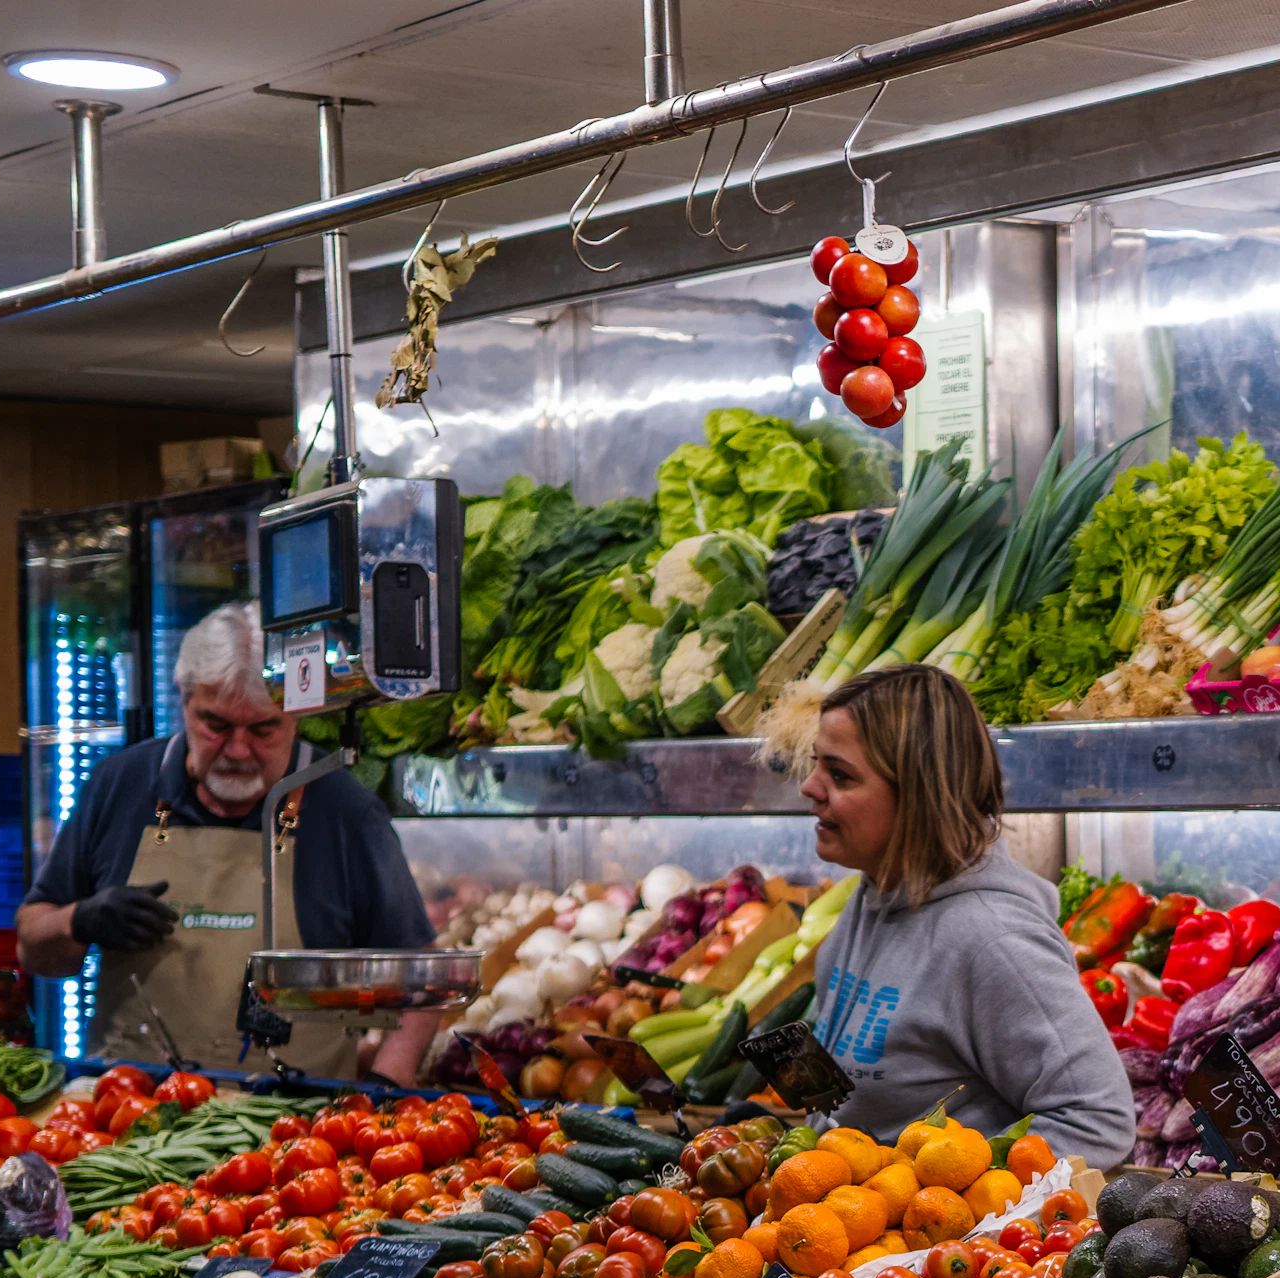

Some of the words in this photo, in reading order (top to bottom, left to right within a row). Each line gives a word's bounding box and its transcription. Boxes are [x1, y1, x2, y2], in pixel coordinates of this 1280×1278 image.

[937, 353, 973, 367] PROHIBIT
[937, 369, 961, 381] TOCAR
[963, 367, 974, 378] EL
[183, 913, 255, 929] Gimeno
[1227, 1038, 1267, 1094] TOMATE
[1210, 1081, 1268, 1157] 4'90
[360, 1238, 435, 1260] CHAMPIÑONES
